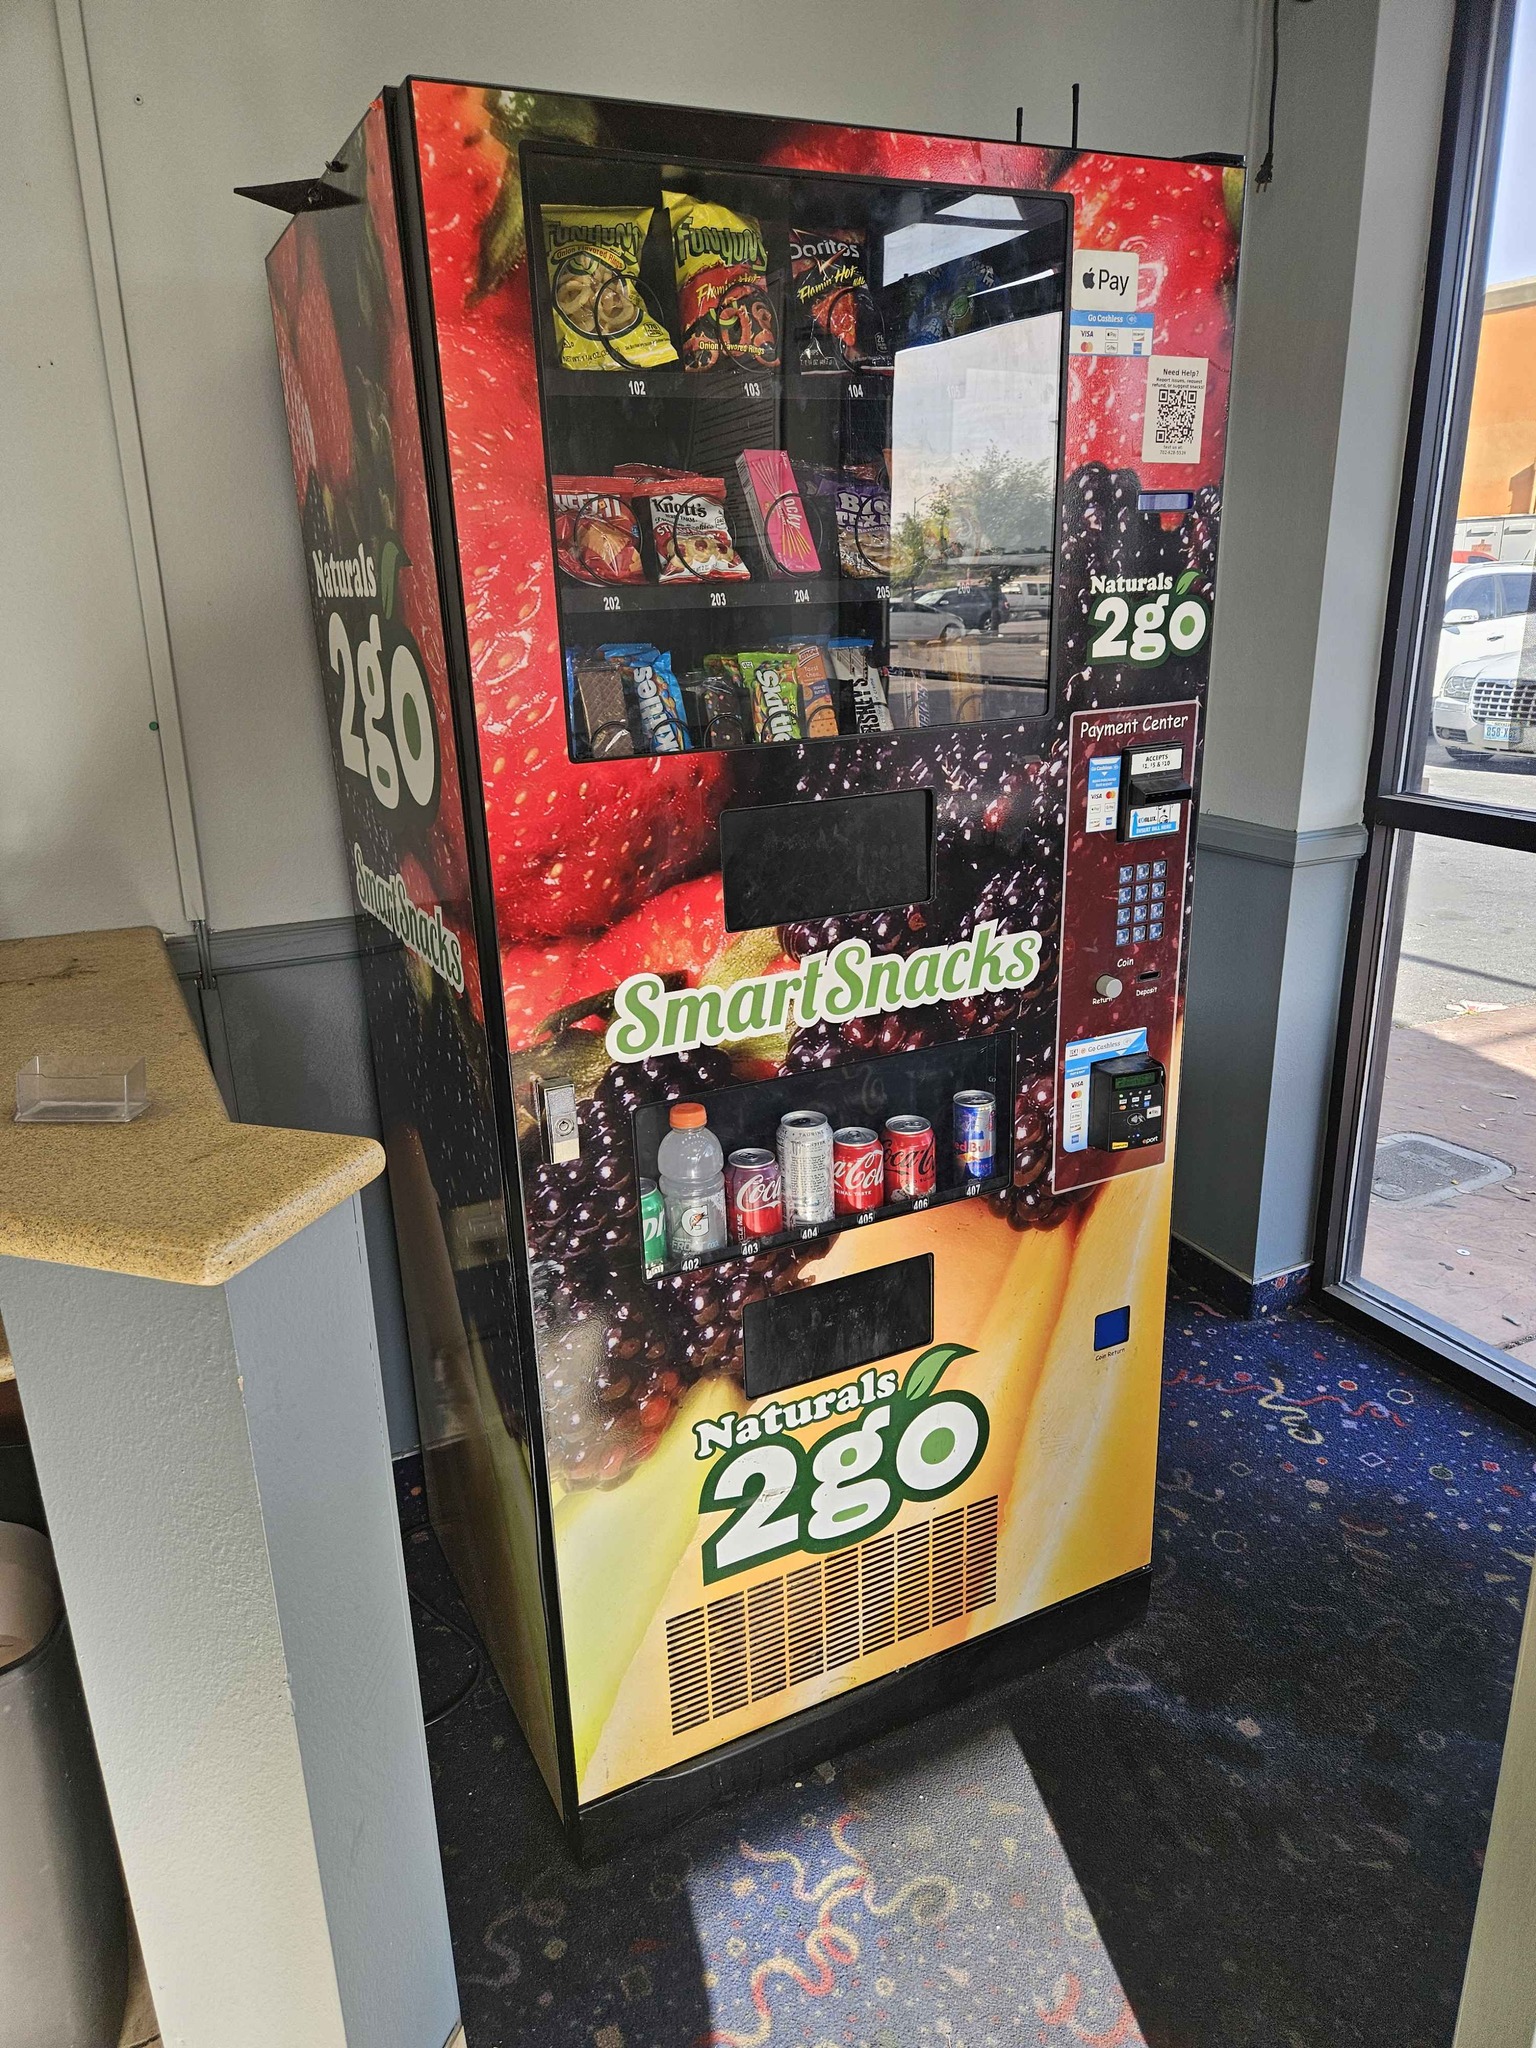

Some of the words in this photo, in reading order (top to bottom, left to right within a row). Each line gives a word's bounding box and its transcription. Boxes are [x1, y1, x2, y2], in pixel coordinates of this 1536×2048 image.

[790, 239, 860, 260] Doritos
[556, 245, 576, 258] Onion
[608, 253, 625, 269] Rings
[796, 275, 834, 304] Flamin'
[834, 264, 858, 283] Hot
[1098, 269, 1130, 296] Pay
[1088, 314, 1096, 322] Go
[1097, 314, 1124, 323] Cashless
[699, 341, 719, 351] Onion
[748, 343, 765, 355] Rings
[1181, 370, 1200, 378] Help?
[628, 380, 646, 395] 102
[744, 382, 761, 397] 103
[848, 384, 864, 398] 104
[651, 496, 708, 518] Knott's
[311, 541, 378, 599] Naturals
[1090, 572, 1174, 595] Naturals
[710, 592, 727, 606] 203
[794, 589, 810, 603] 204
[876, 586, 891, 599] 205
[603, 595, 621, 611] 202
[1092, 593, 1207, 662] 2go
[328, 611, 436, 811] 2go
[634, 666, 680, 752] kittles
[1080, 719, 1138, 741] Payment
[1142, 715, 1189, 732] Center
[1145, 754, 1168, 762] ACCEPTS
[1117, 957, 1134, 968] Coin
[613, 925, 1040, 1057] SmartSnacks
[1136, 987, 1158, 997] Deposit
[1092, 997, 1112, 1005] Return
[1096, 1042, 1121, 1051] Cashless
[969, 1141, 991, 1153] Bull
[966, 1184, 981, 1197] 407
[914, 1199, 928, 1211] 406
[858, 1212, 874, 1225] 405
[802, 1227, 818, 1240] 404
[742, 1242, 758, 1256] 403
[682, 1258, 700, 1271] 402
[1108, 1347, 1125, 1358] Return
[695, 1370, 897, 1457] Naturals
[714, 1401, 979, 1569] 2go
